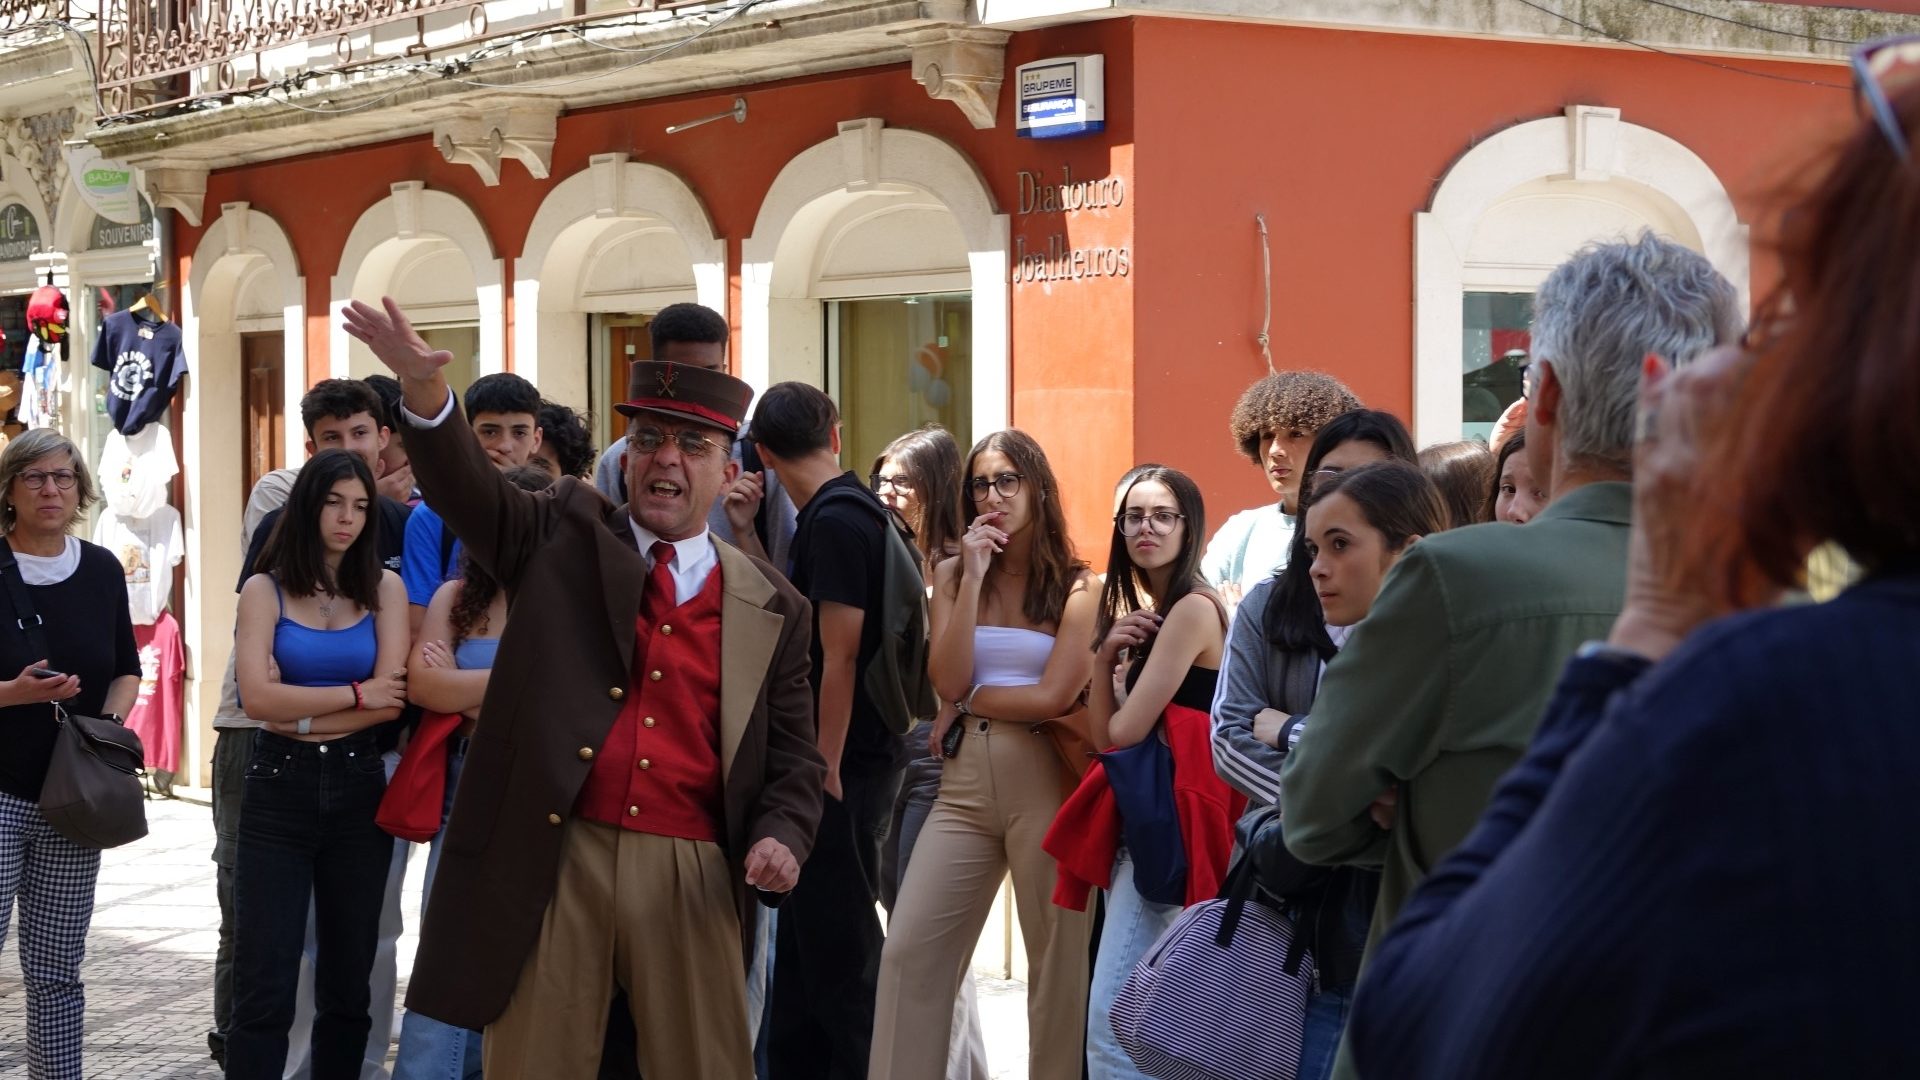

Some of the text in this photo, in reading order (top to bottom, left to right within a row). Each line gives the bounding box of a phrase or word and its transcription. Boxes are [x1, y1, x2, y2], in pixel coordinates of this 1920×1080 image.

[1023, 78, 1073, 93] GRUPEME
[88, 172, 123, 183] BAIXA
[1017, 165, 1124, 215] Diadouro
[100, 223, 153, 247] SOUVENIRS
[1014, 233, 1130, 283] Joalheiros
